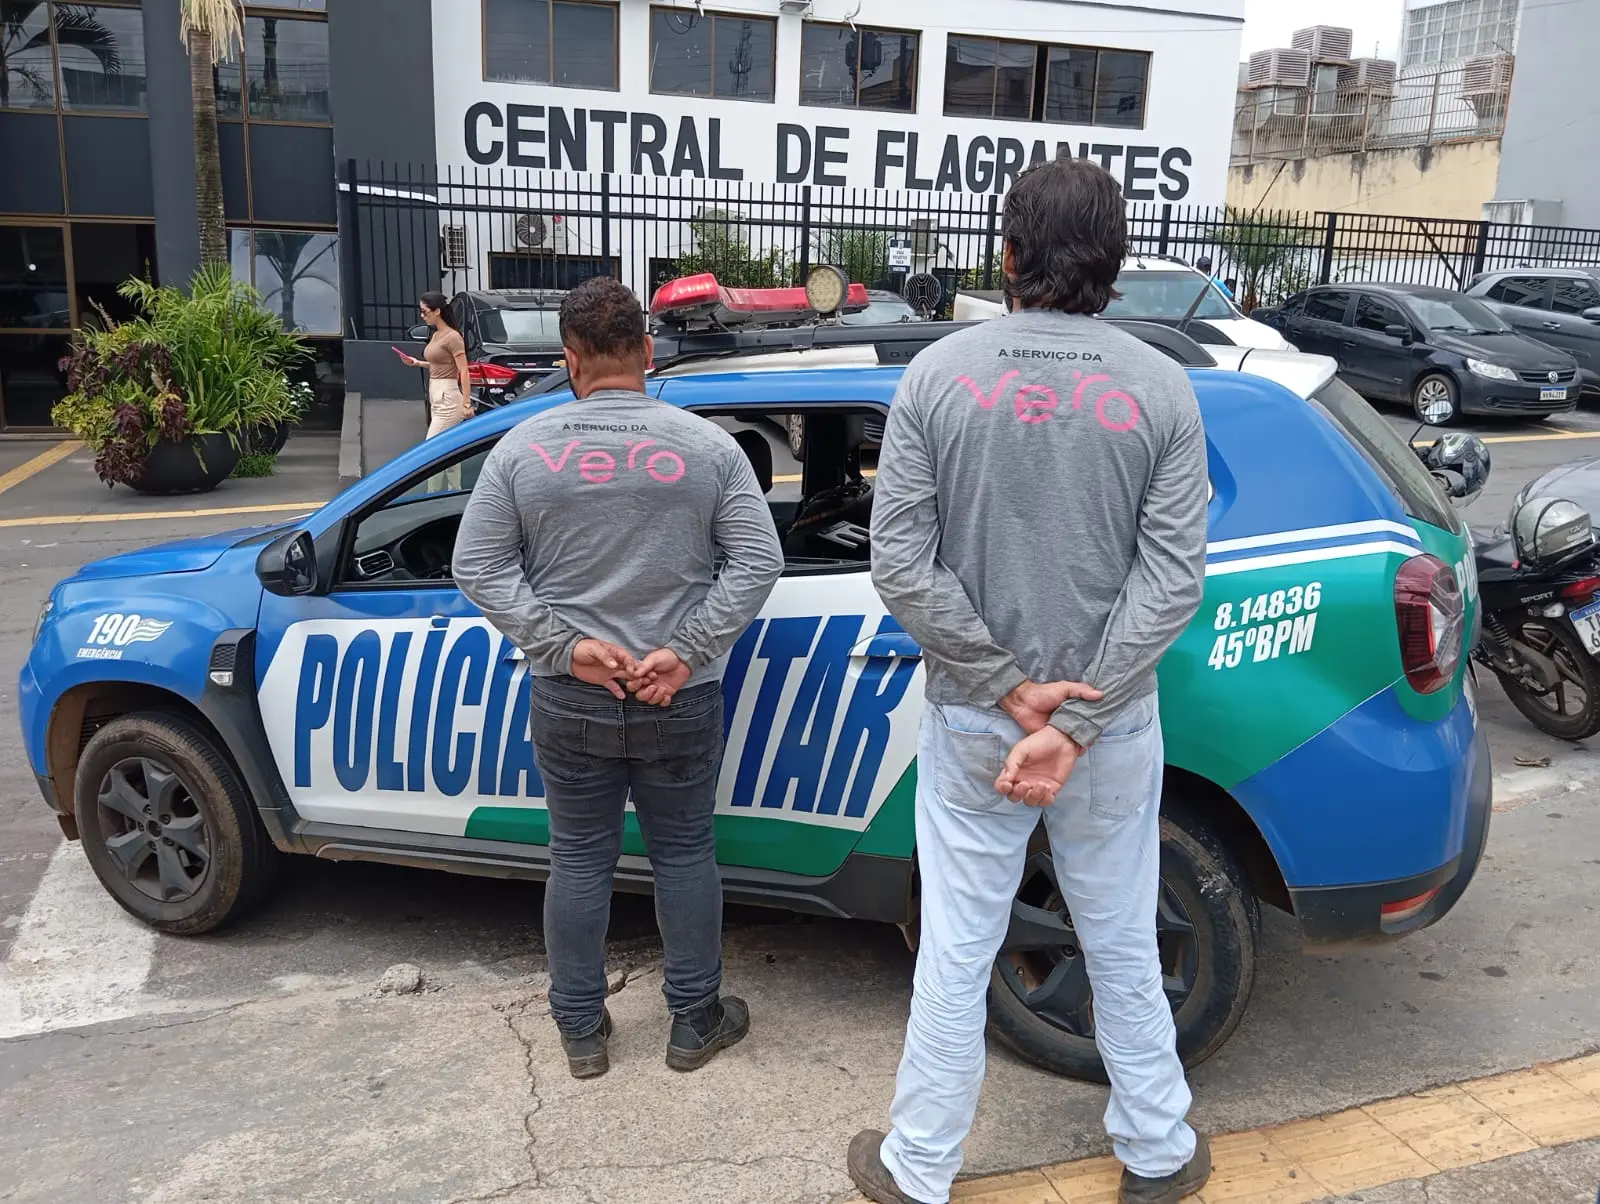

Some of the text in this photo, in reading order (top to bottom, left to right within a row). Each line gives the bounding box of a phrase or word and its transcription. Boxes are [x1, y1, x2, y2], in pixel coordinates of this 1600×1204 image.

[464, 102, 1192, 201] CENTRAL DE FLAGRTES
[998, 349, 1103, 362] A SERVIÇO DA
[562, 423, 648, 432] A SERVIÇO DA
[1520, 591, 1555, 604] SPORT
[1213, 581, 1322, 631] 8.14836
[86, 613, 142, 646] 190
[76, 647, 124, 660] EMERGÊNCIA
